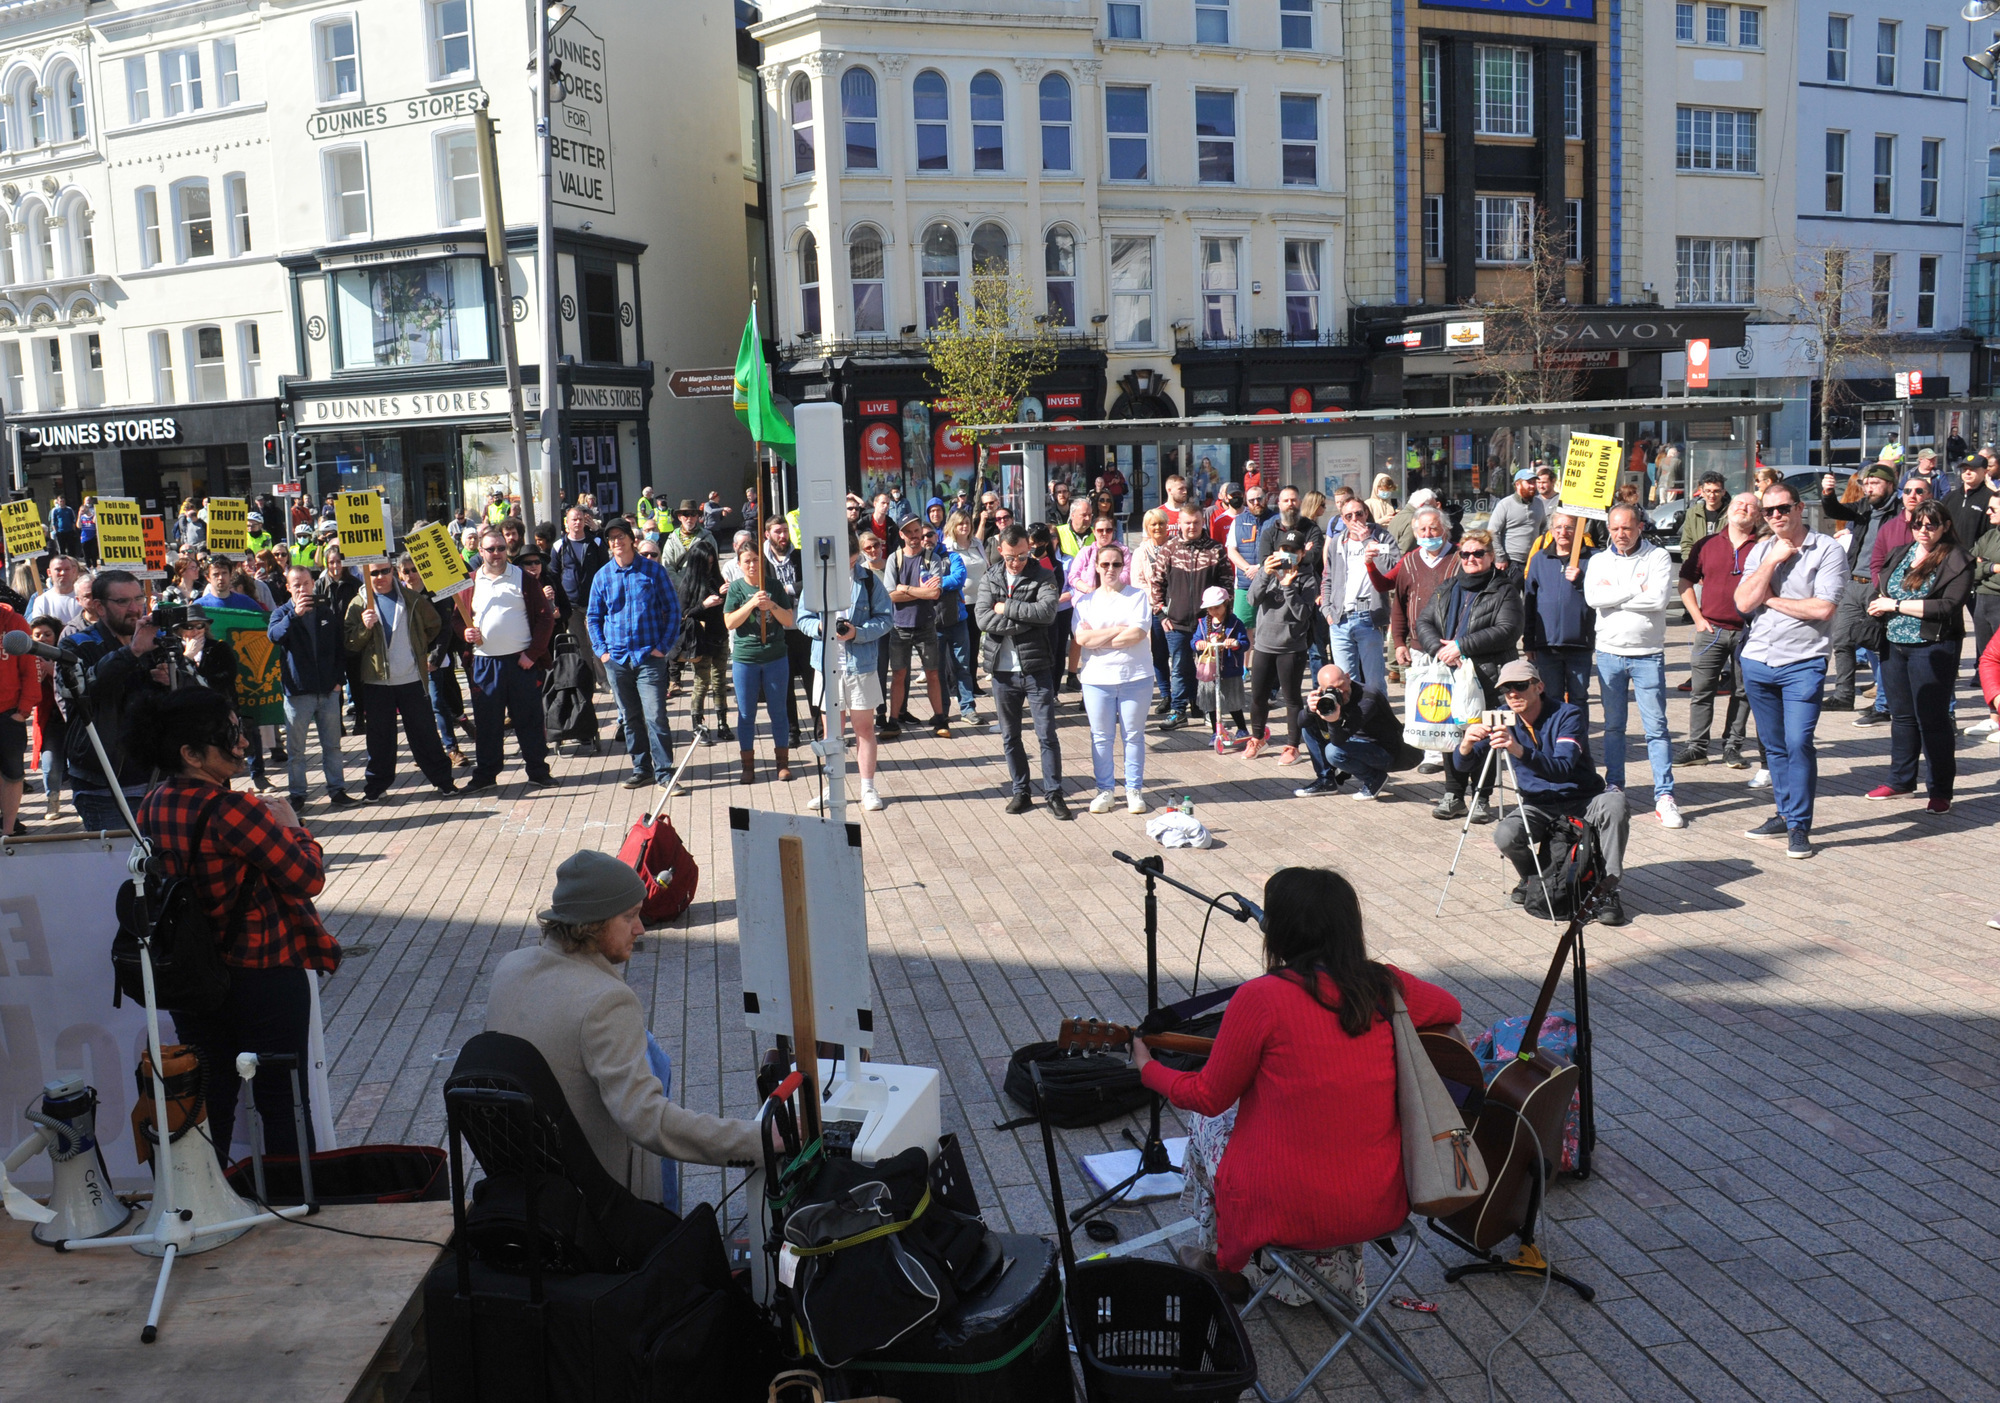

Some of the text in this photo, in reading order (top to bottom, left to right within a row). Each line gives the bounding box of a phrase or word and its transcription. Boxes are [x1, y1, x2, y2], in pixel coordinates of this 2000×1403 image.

[549, 35, 601, 71] UNNES
[564, 73, 603, 104] ORES
[317, 92, 479, 134] DUNNES STORES
[568, 111, 586, 127] FOR
[551, 135, 606, 170] BETTER
[559, 171, 603, 200] VALUE
[442, 244, 458, 253] 105
[354, 249, 418, 264] BETTER VALUE
[1551, 323, 1685, 340] SAVOY
[1542, 351, 1612, 362] CHAMPION
[689, 375, 712, 383] Margadh
[688, 385, 710, 393] English
[610, 389, 640, 407] STORES
[1047, 396, 1080, 406] INVEST
[317, 391, 491, 420] DUNNES STORES
[867, 403, 890, 413] LIVE
[104, 418, 176, 442] STORES
[1572, 438, 1590, 447] WHO
[1570, 448, 1593, 458] Policy
[1568, 459, 1585, 467] says
[1566, 468, 1581, 477] END
[1593, 445, 1612, 498] LOCKDOWN
[346, 494, 369, 507] Tell
[7, 502, 29, 516] END
[99, 513, 139, 525] TRUTH
[210, 510, 245, 521] TRUTH
[349, 513, 370, 524] the
[5, 521, 40, 534] LOCKDOWN
[8, 535, 17, 543] go
[18, 532, 34, 540] back
[103, 534, 126, 542] Shame
[340, 528, 383, 544] TRUTH!
[405, 533, 421, 545] WHO
[13, 540, 42, 554] WORK
[211, 538, 244, 549] DEVIL!
[409, 541, 429, 553] Policy
[104, 546, 142, 558] DEVIL!
[414, 552, 429, 562] says
[430, 528, 459, 575] LOCKDOWN
[417, 560, 432, 571] END
[421, 571, 434, 580] the
[238, 693, 283, 706] GO BRA
